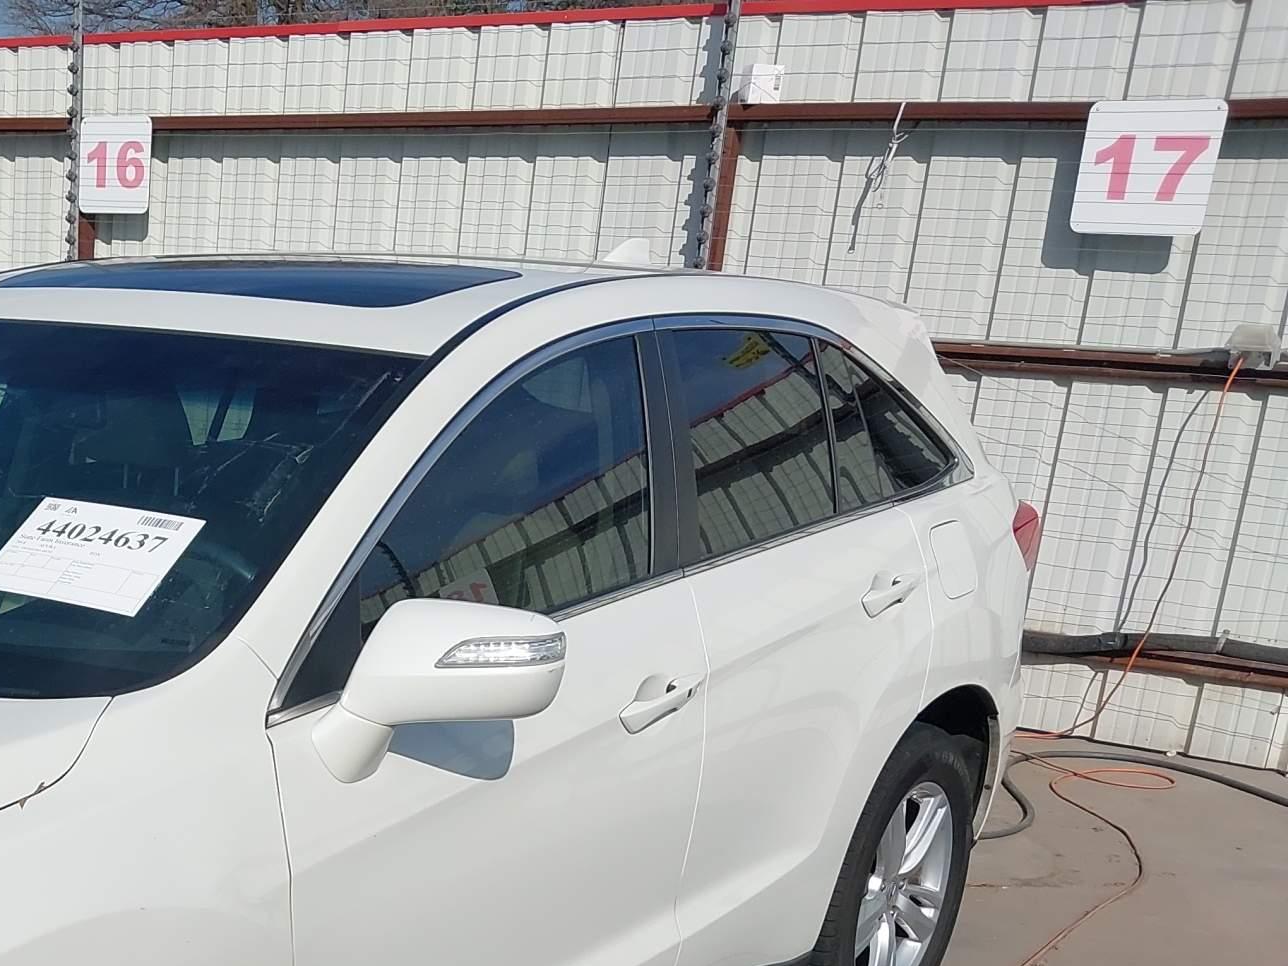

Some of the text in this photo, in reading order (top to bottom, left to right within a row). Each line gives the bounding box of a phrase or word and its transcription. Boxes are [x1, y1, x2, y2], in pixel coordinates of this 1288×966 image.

[87, 140, 145, 189] 16
[1094, 134, 1212, 202] 17
[37, 519, 169, 553] 44024637
